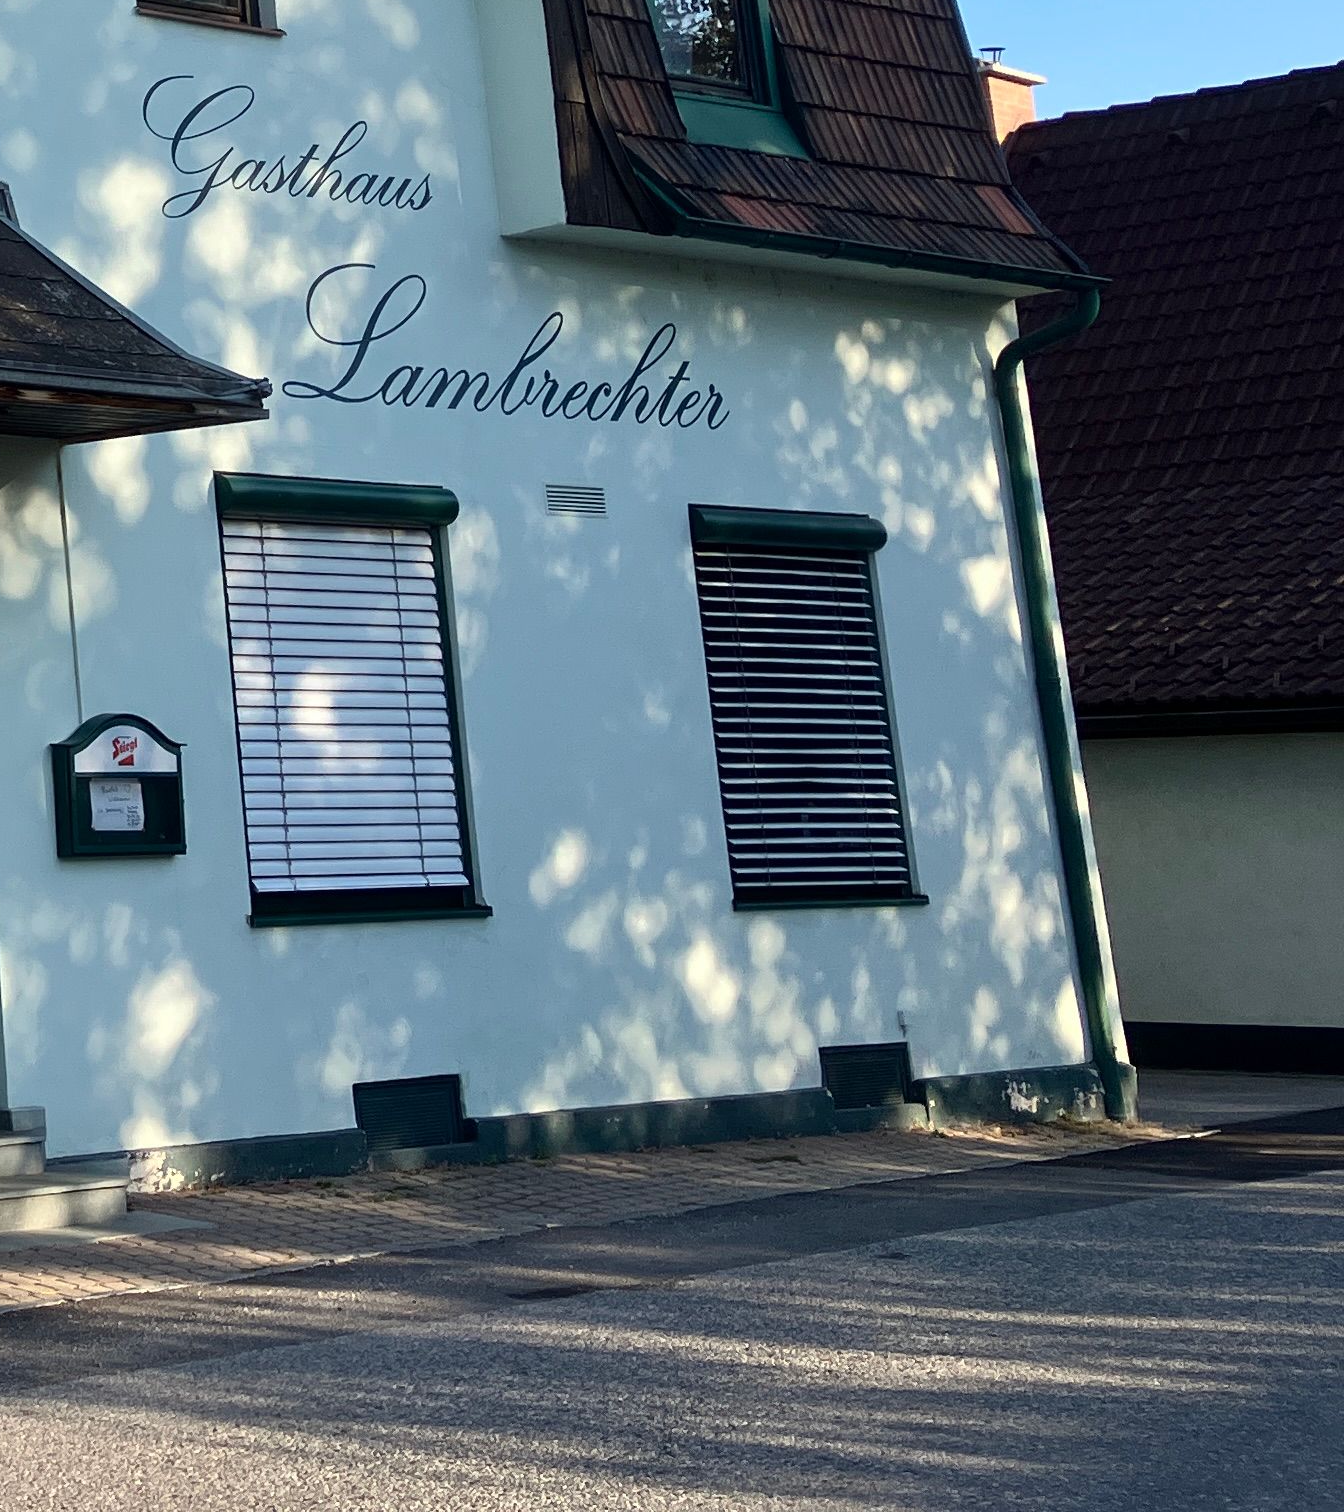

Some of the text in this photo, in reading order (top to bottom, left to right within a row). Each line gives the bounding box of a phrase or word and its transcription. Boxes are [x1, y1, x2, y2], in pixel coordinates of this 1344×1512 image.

[143, 75, 433, 219] Gasthaus
[282, 262, 730, 430] Lambrechter
[112, 736, 138, 760] Stiegl
